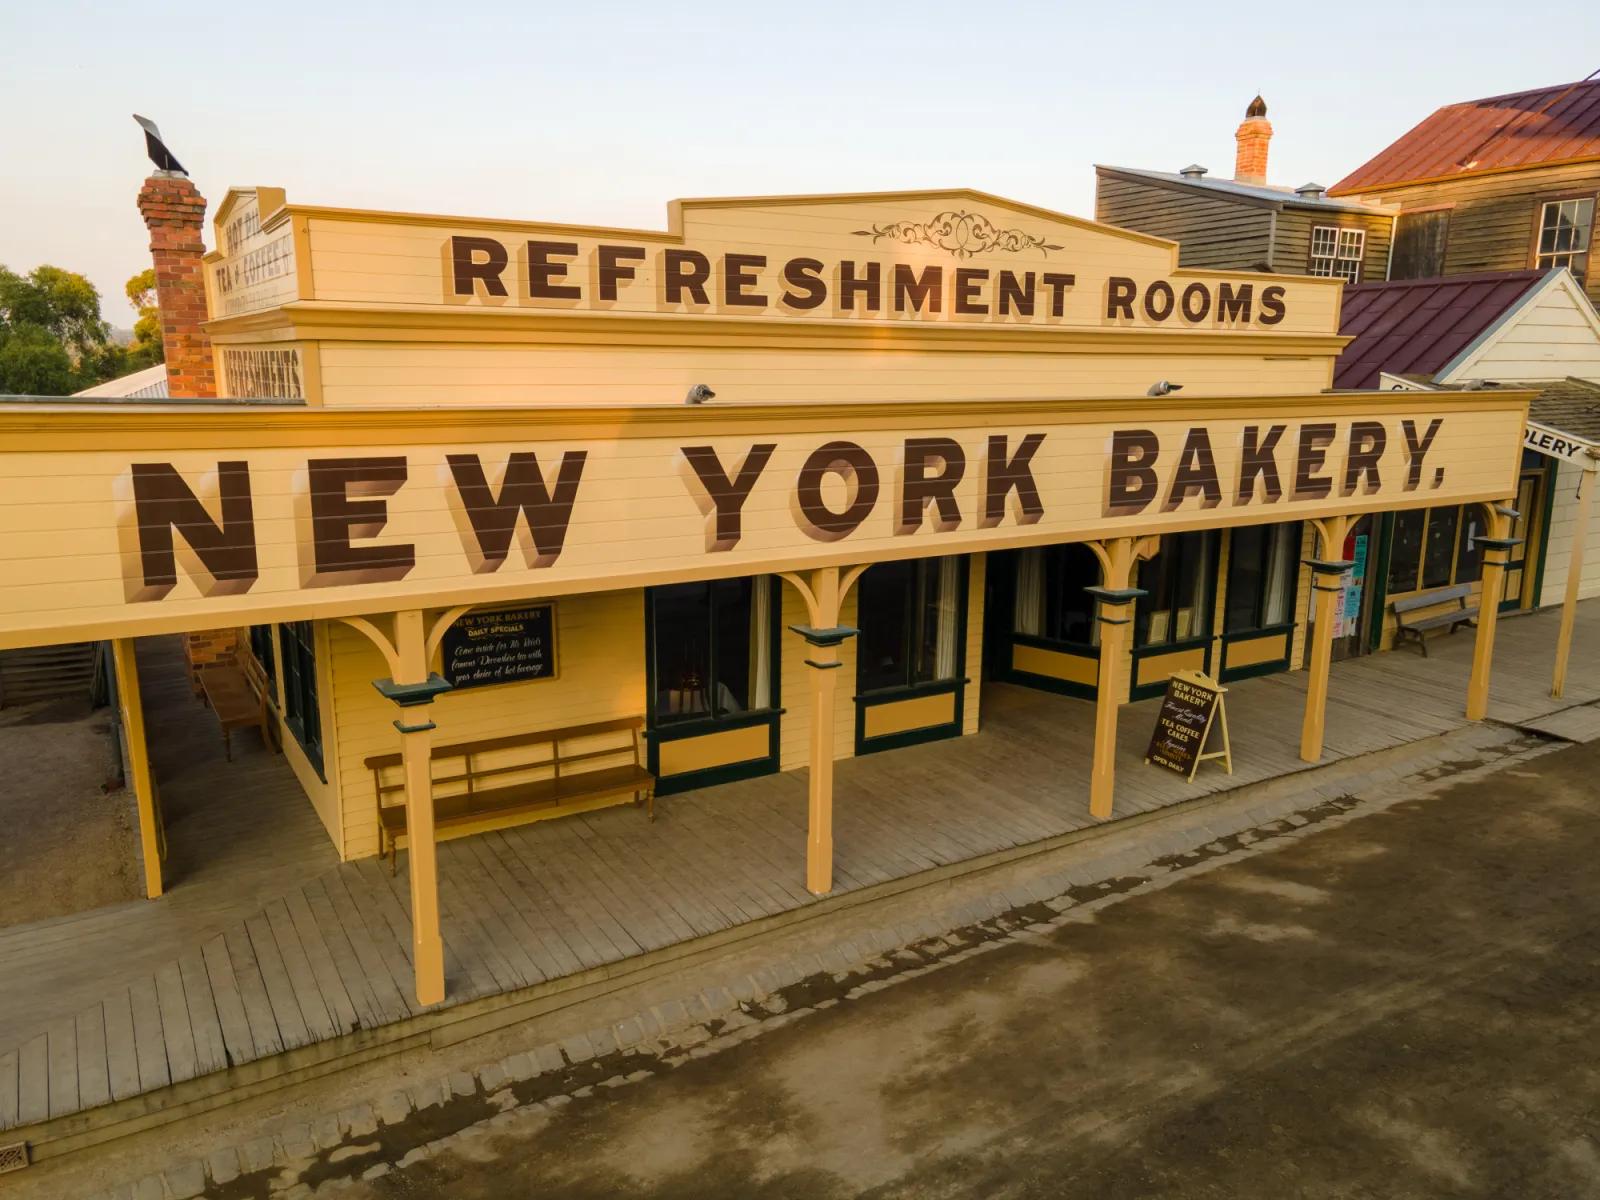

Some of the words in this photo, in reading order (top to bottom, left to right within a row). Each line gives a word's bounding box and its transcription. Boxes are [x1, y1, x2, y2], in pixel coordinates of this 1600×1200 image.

[216, 264, 232, 297] TEA
[243, 244, 281, 287] COFFEE
[452, 235, 1075, 318] REFRESHMENT
[1107, 275, 1286, 325] ROOMS
[223, 348, 301, 398] REFRESHMENTS
[128, 450, 588, 590] NEW
[677, 433, 1048, 546] YORK
[1107, 418, 1445, 510] BAKERY.
[477, 613, 503, 625] YORK
[504, 610, 542, 622] BAKERY
[468, 627, 488, 638] DAILY
[490, 624, 524, 634] SPECIALS
[1172, 681, 1190, 693] NEW
[1191, 687, 1214, 702] YORK
[1174, 691, 1207, 708] BAKERY
[1161, 718, 1175, 729] TEA
[1176, 722, 1201, 740] COFFEE
[1167, 729, 1189, 743] CAKES
[1153, 754, 1168, 766] OPEN
[1168, 762, 1185, 773] DAILY
